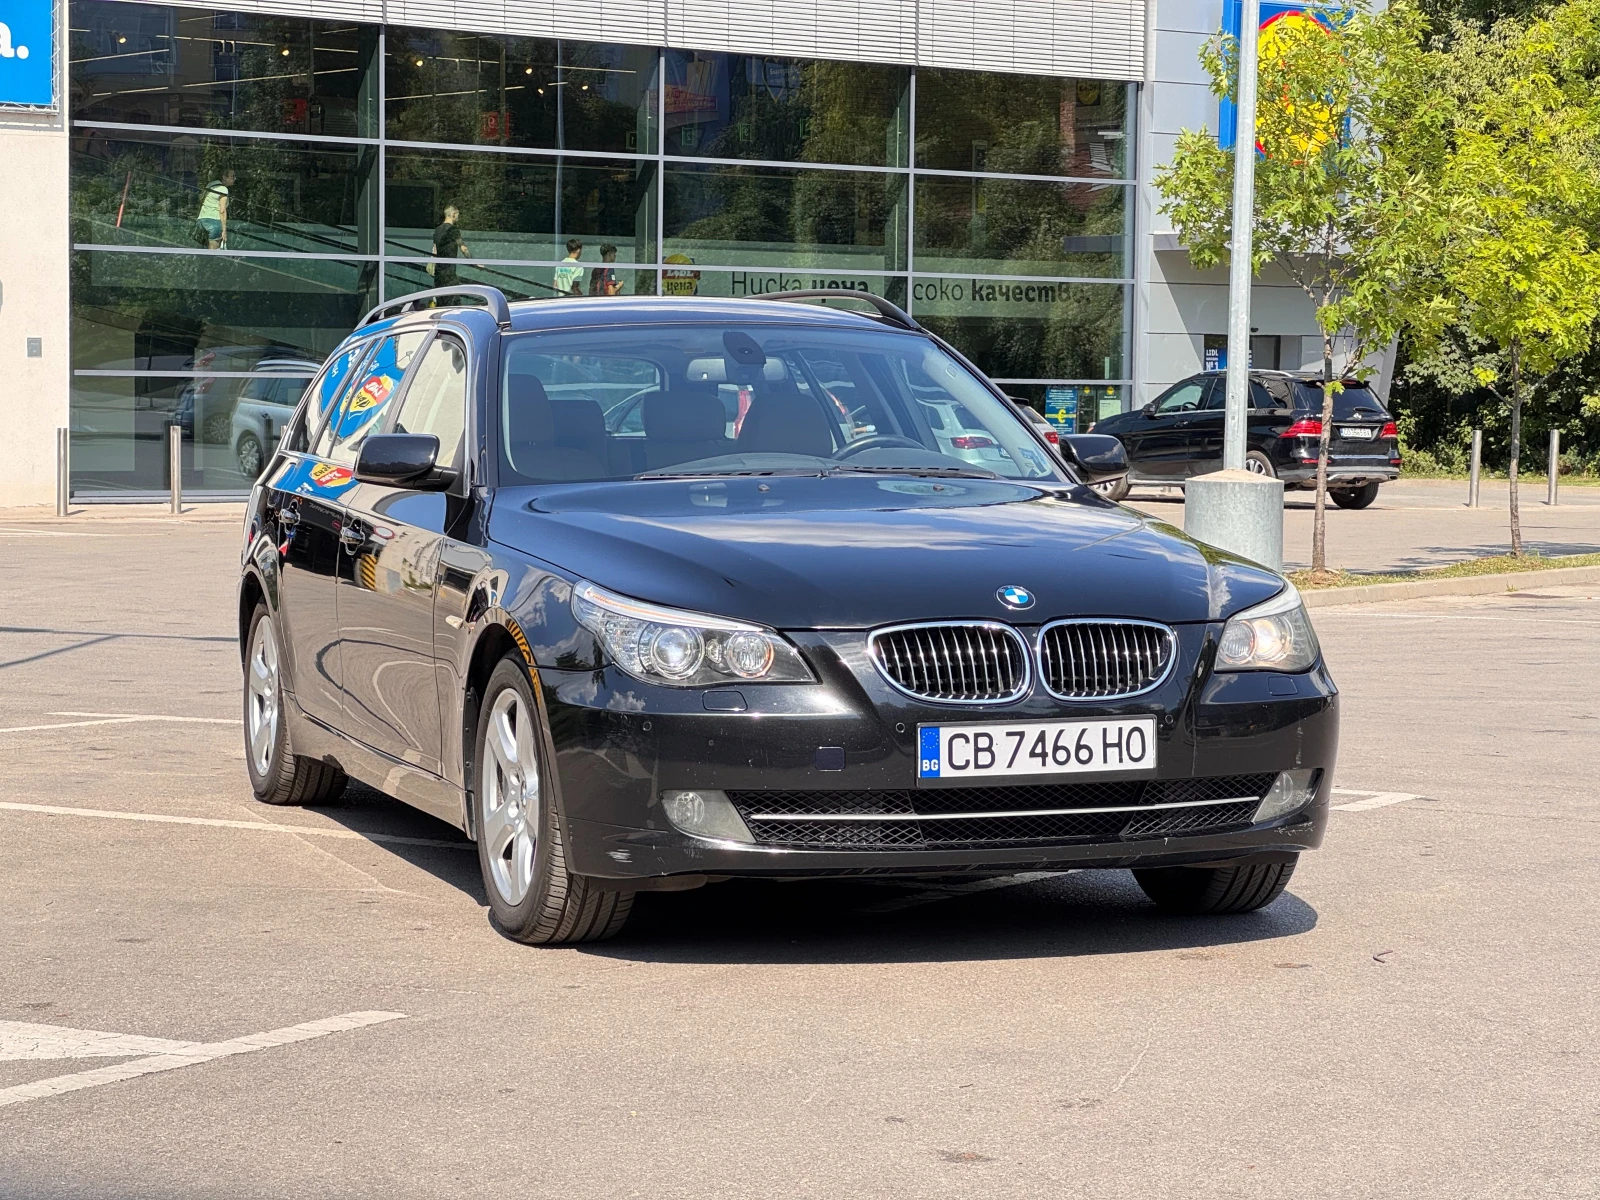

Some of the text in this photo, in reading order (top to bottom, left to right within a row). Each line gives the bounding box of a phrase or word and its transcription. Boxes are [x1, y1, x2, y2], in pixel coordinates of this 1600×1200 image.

[666, 281, 693, 295] цена
[731, 271, 802, 295] Ниска
[947, 726, 1147, 770] CB 7466 HO
[922, 759, 939, 771] BG
